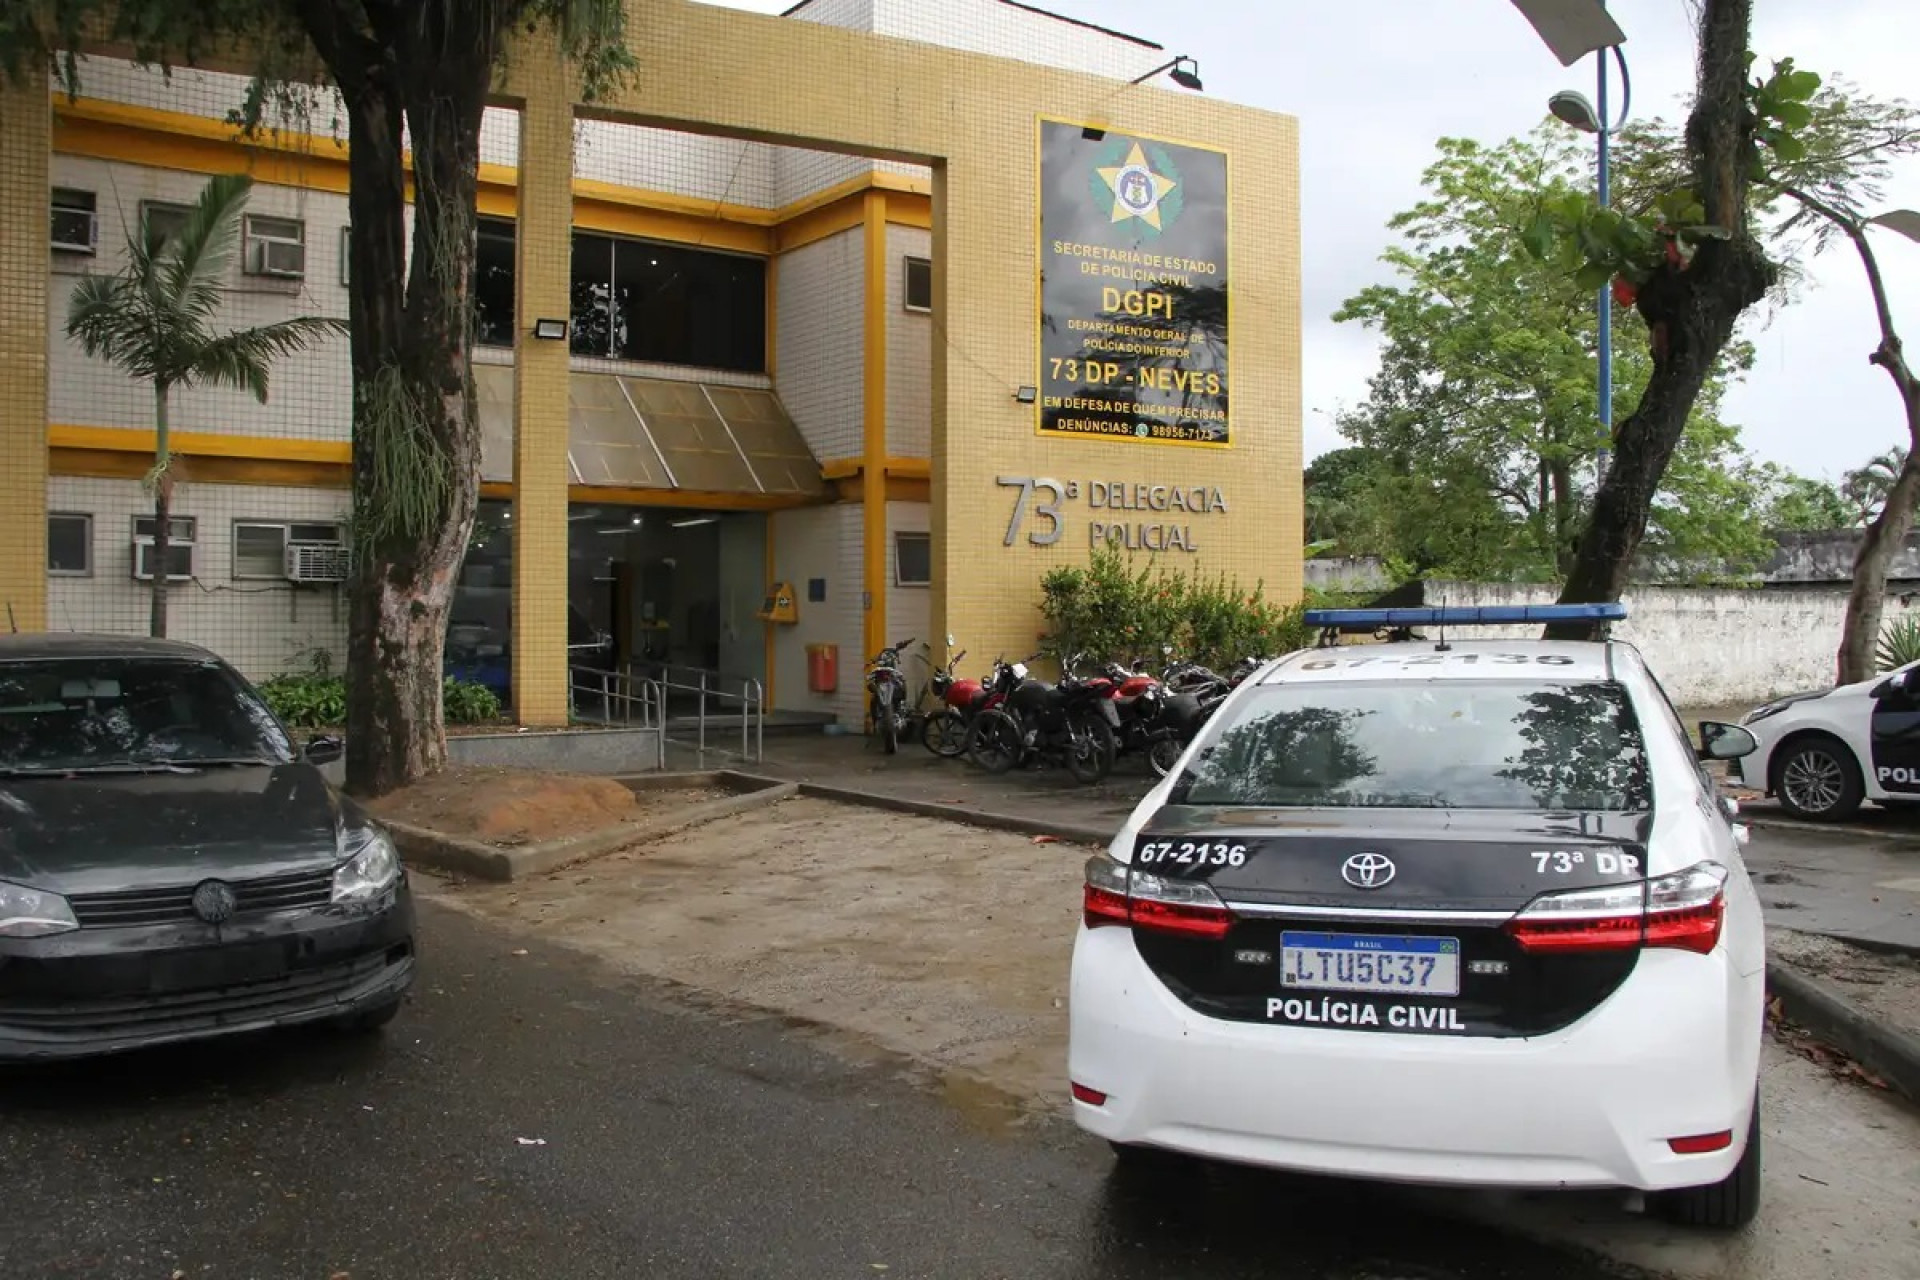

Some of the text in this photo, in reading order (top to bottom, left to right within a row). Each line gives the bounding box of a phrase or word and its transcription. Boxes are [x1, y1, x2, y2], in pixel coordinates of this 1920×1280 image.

[1053, 241, 1217, 275] SECRETARIA DE ESTADO
[1081, 261, 1099, 276] DE
[1159, 272, 1194, 288] CIVIL
[1103, 287, 1173, 320] DGPI
[1068, 319, 1205, 344] DEPARTAMENTO GERAL DE
[1143, 345, 1190, 359] INTERIOR
[1050, 357, 1078, 382] 73
[1085, 361, 1119, 384] DP
[1140, 367, 1220, 395] NEVES
[1044, 396, 1225, 421] EM DEFESA DE QUEM PRECISAR
[1057, 417, 1133, 434] DENÚNCIAS:
[1089, 480, 1228, 514] DELEGACIA
[1089, 521, 1198, 551] POLICIAL
[1139, 842, 1247, 867] 67-2136
[1596, 854, 1640, 876] DP
[1353, 941, 1383, 949] BRASIL
[1297, 951, 1436, 987] LTU5C37
[1266, 997, 1465, 1030] POLÍCIA CIVIL
